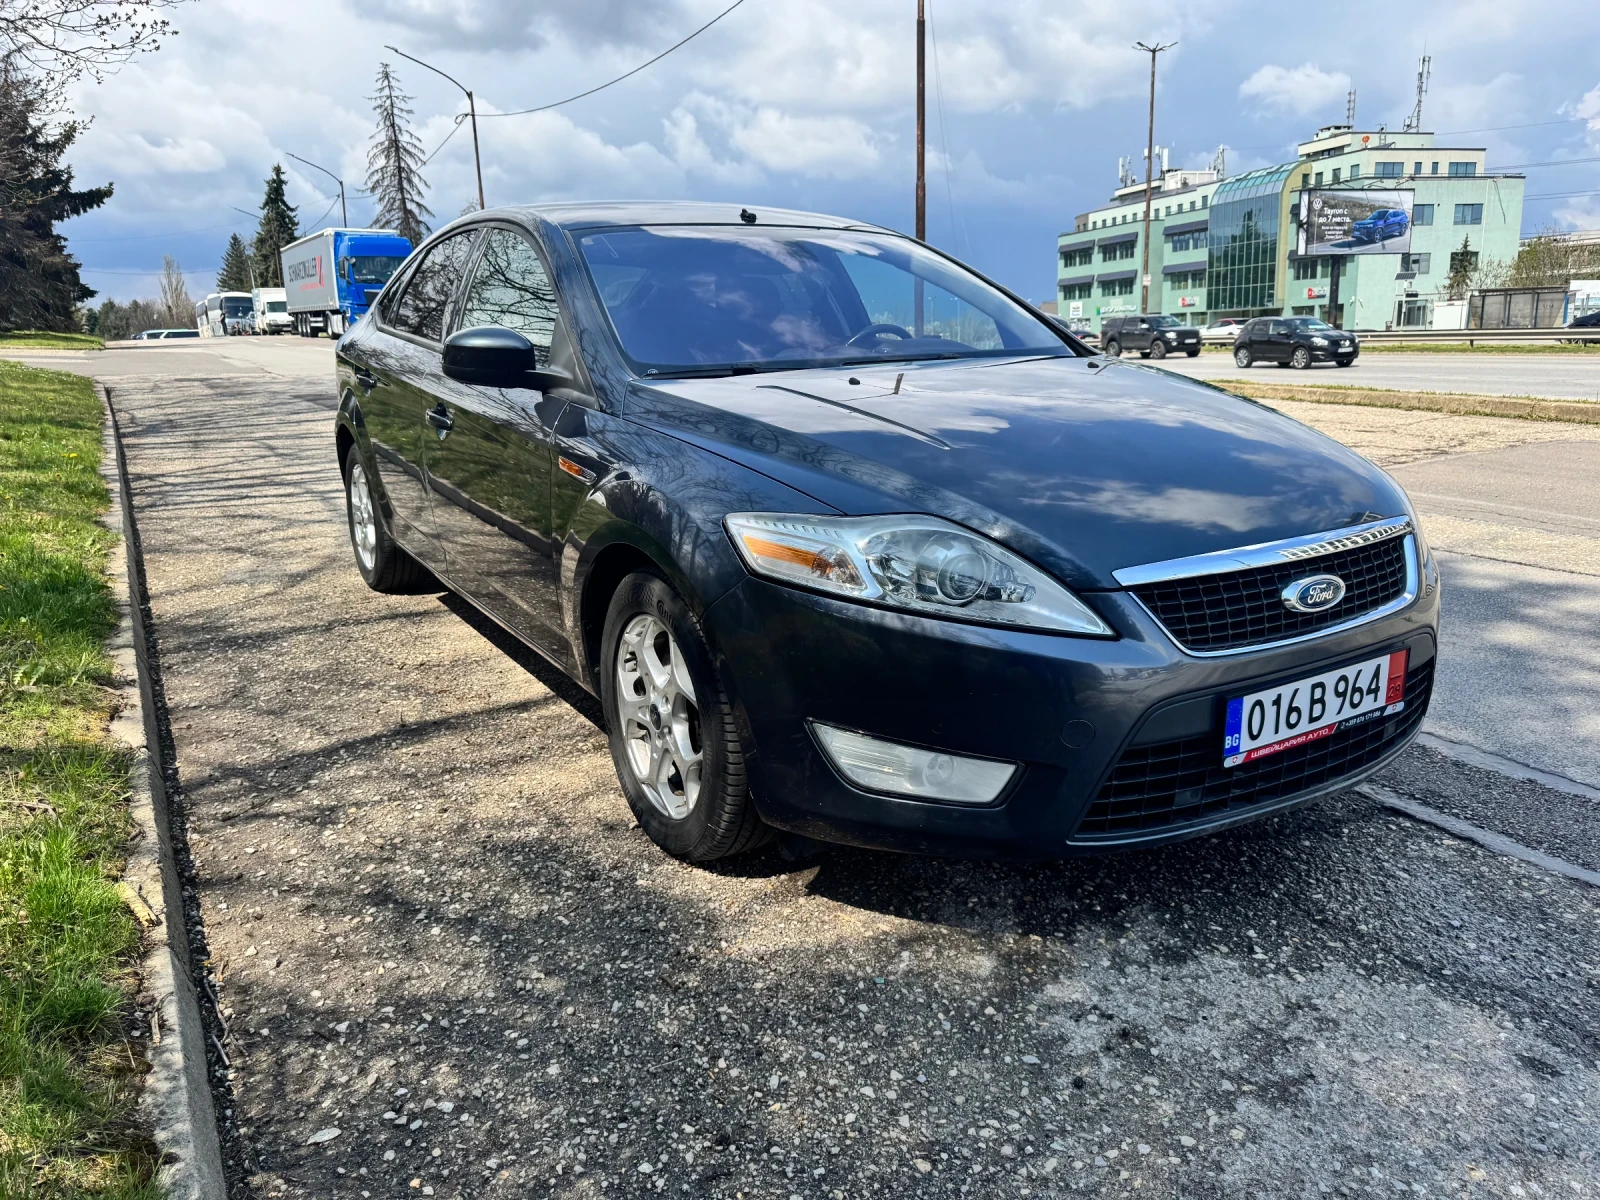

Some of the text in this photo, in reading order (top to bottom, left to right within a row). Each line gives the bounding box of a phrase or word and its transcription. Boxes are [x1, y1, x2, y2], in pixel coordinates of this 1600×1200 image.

[1307, 583, 1334, 604] Ford
[1225, 735, 1240, 749] BG
[1250, 728, 1329, 758] ШВЕЙЦАРИЯ АУТО
